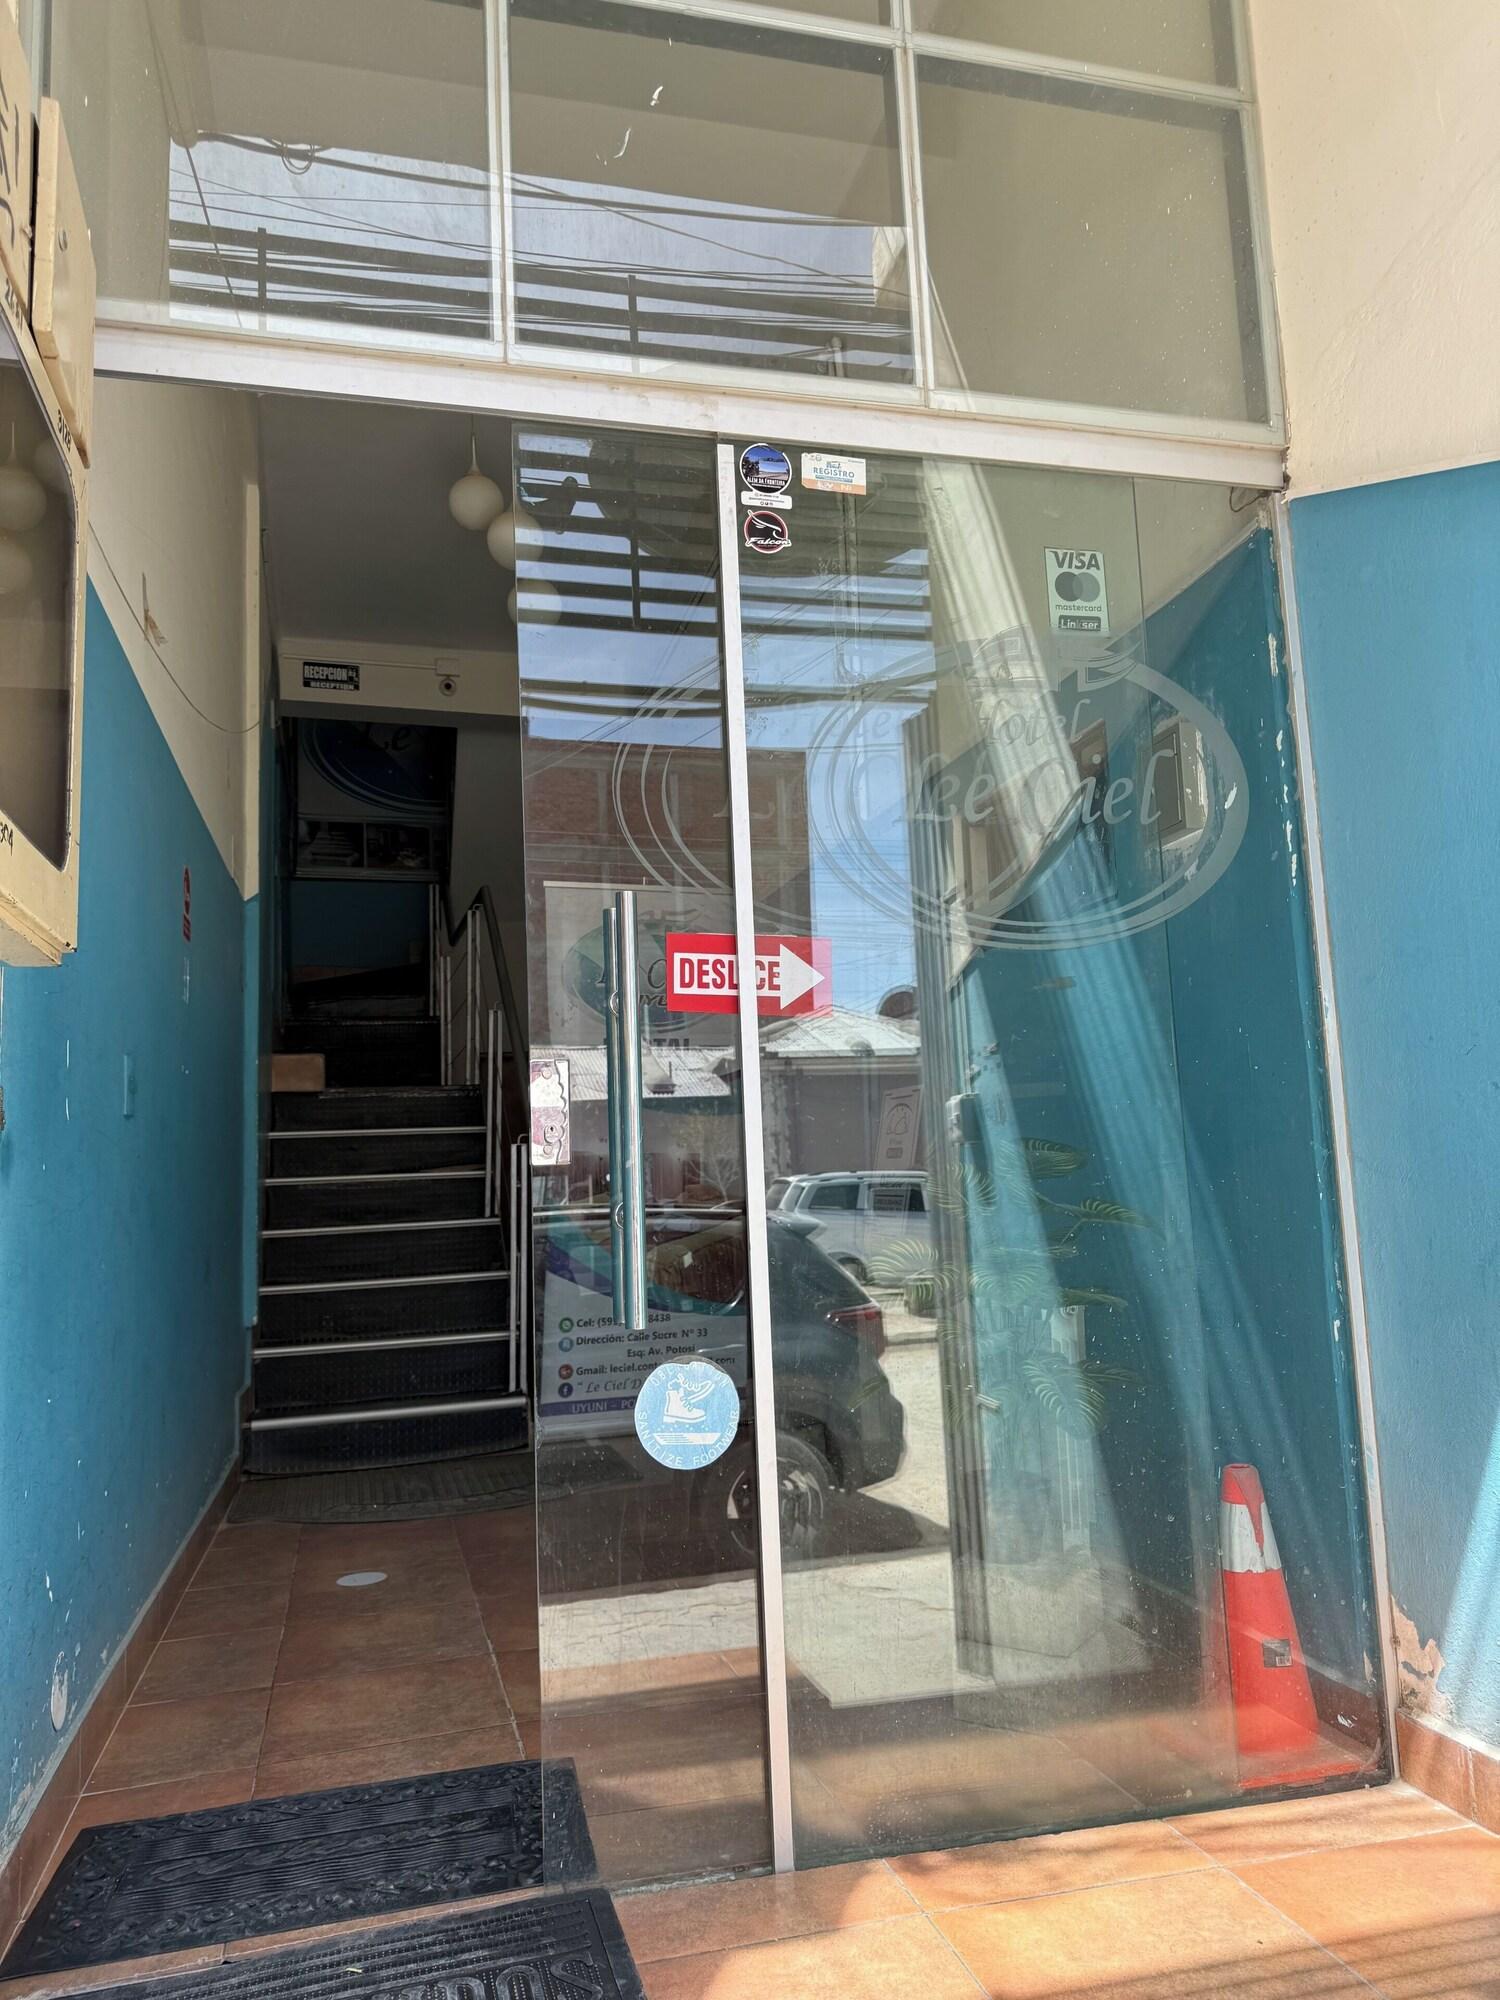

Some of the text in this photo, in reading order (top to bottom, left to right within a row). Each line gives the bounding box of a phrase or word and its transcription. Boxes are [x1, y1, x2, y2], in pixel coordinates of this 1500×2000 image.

[813, 466, 855, 479] REGISTRO
[748, 536, 788, 545] Falcon
[1049, 550, 1101, 571] VISA
[1055, 603, 1102, 612] mastercard
[679, 957, 781, 991] DESLCE
[576, 1318, 595, 1328] Cel:
[575, 1332, 625, 1346] Dirección:
[652, 1331, 679, 1341] Sucre
[696, 1328, 709, 1337] 33
[627, 1348, 646, 1359] Esq:
[648, 1347, 664, 1356] Av.
[575, 1364, 608, 1376] Gmail:
[571, 1402, 608, 1414] UYUNI
[637, 1410, 684, 1467] SANITIZE
[692, 1409, 739, 1466] FOOTWEAR
